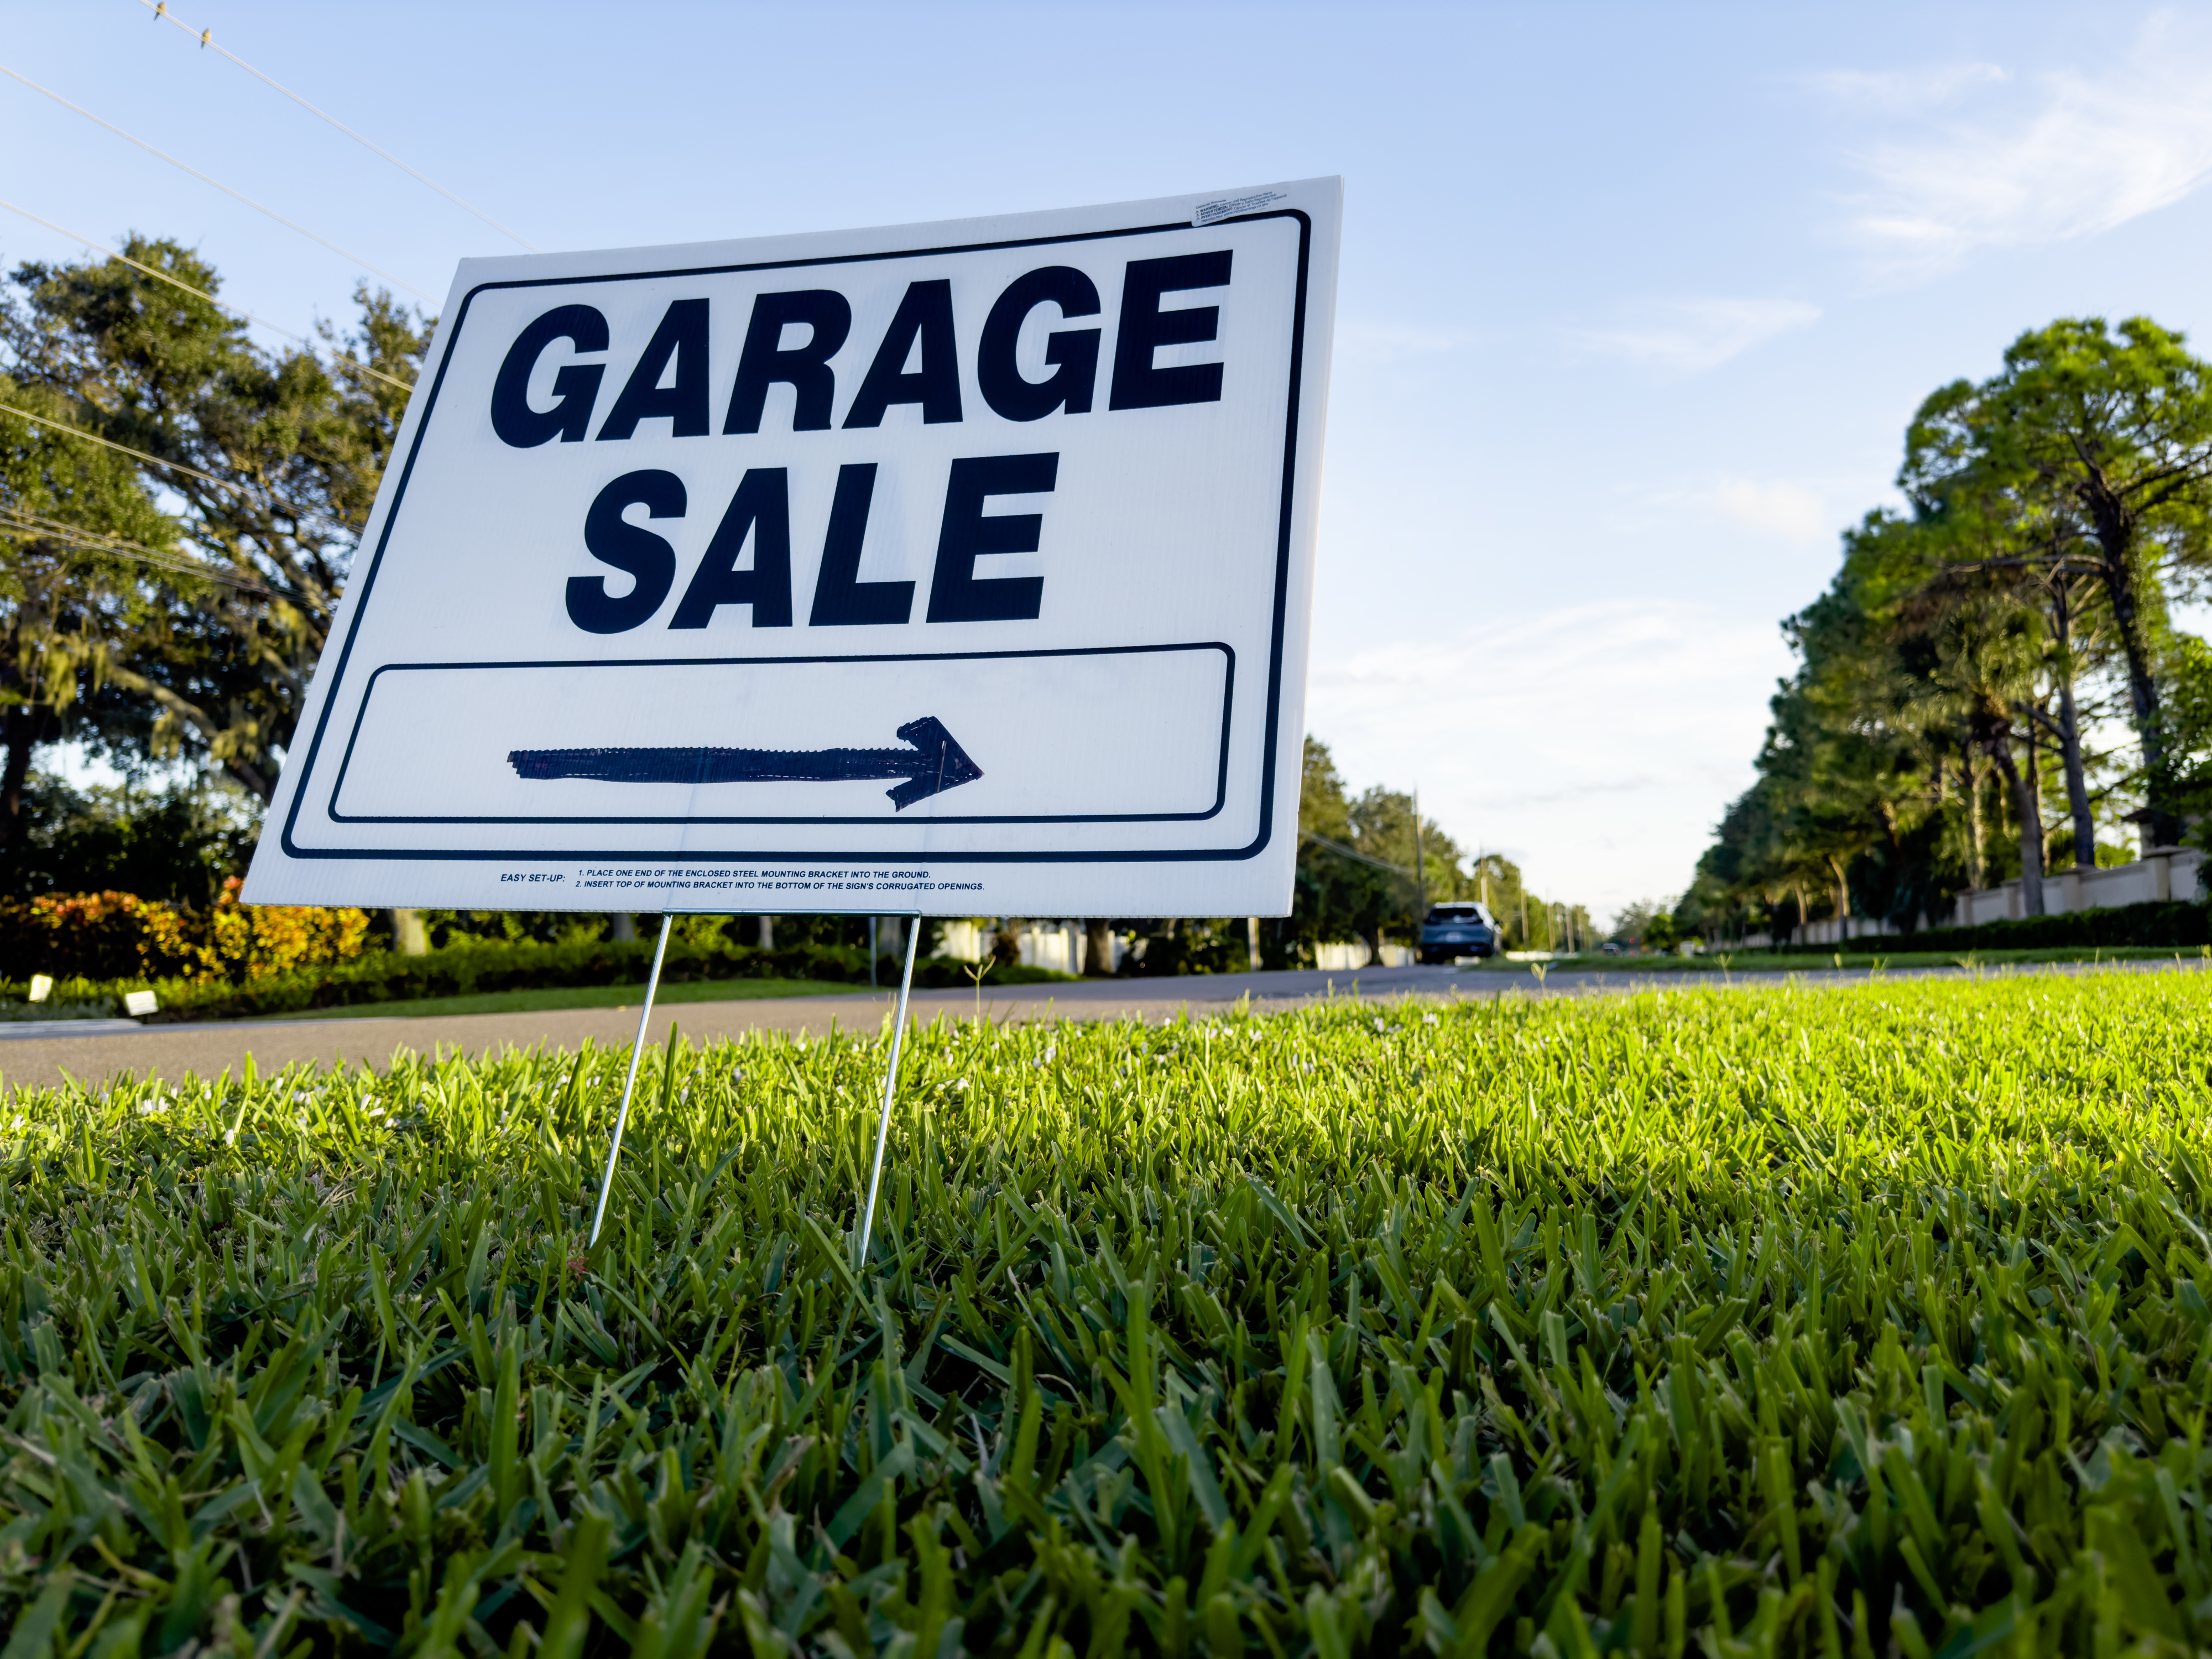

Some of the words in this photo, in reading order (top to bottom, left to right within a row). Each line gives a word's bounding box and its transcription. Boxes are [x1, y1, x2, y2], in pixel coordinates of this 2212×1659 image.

[1199, 204, 1219, 212] WARNING:
[1200, 206, 1228, 216] ADVERTENCIA:
[1201, 207, 1233, 220] AVERTISSEMENT:
[491, 249, 1234, 448] GARAGE
[565, 452, 1060, 634] SALE
[500, 874, 527, 882] EASY
[528, 874, 566, 882] SET-UP:
